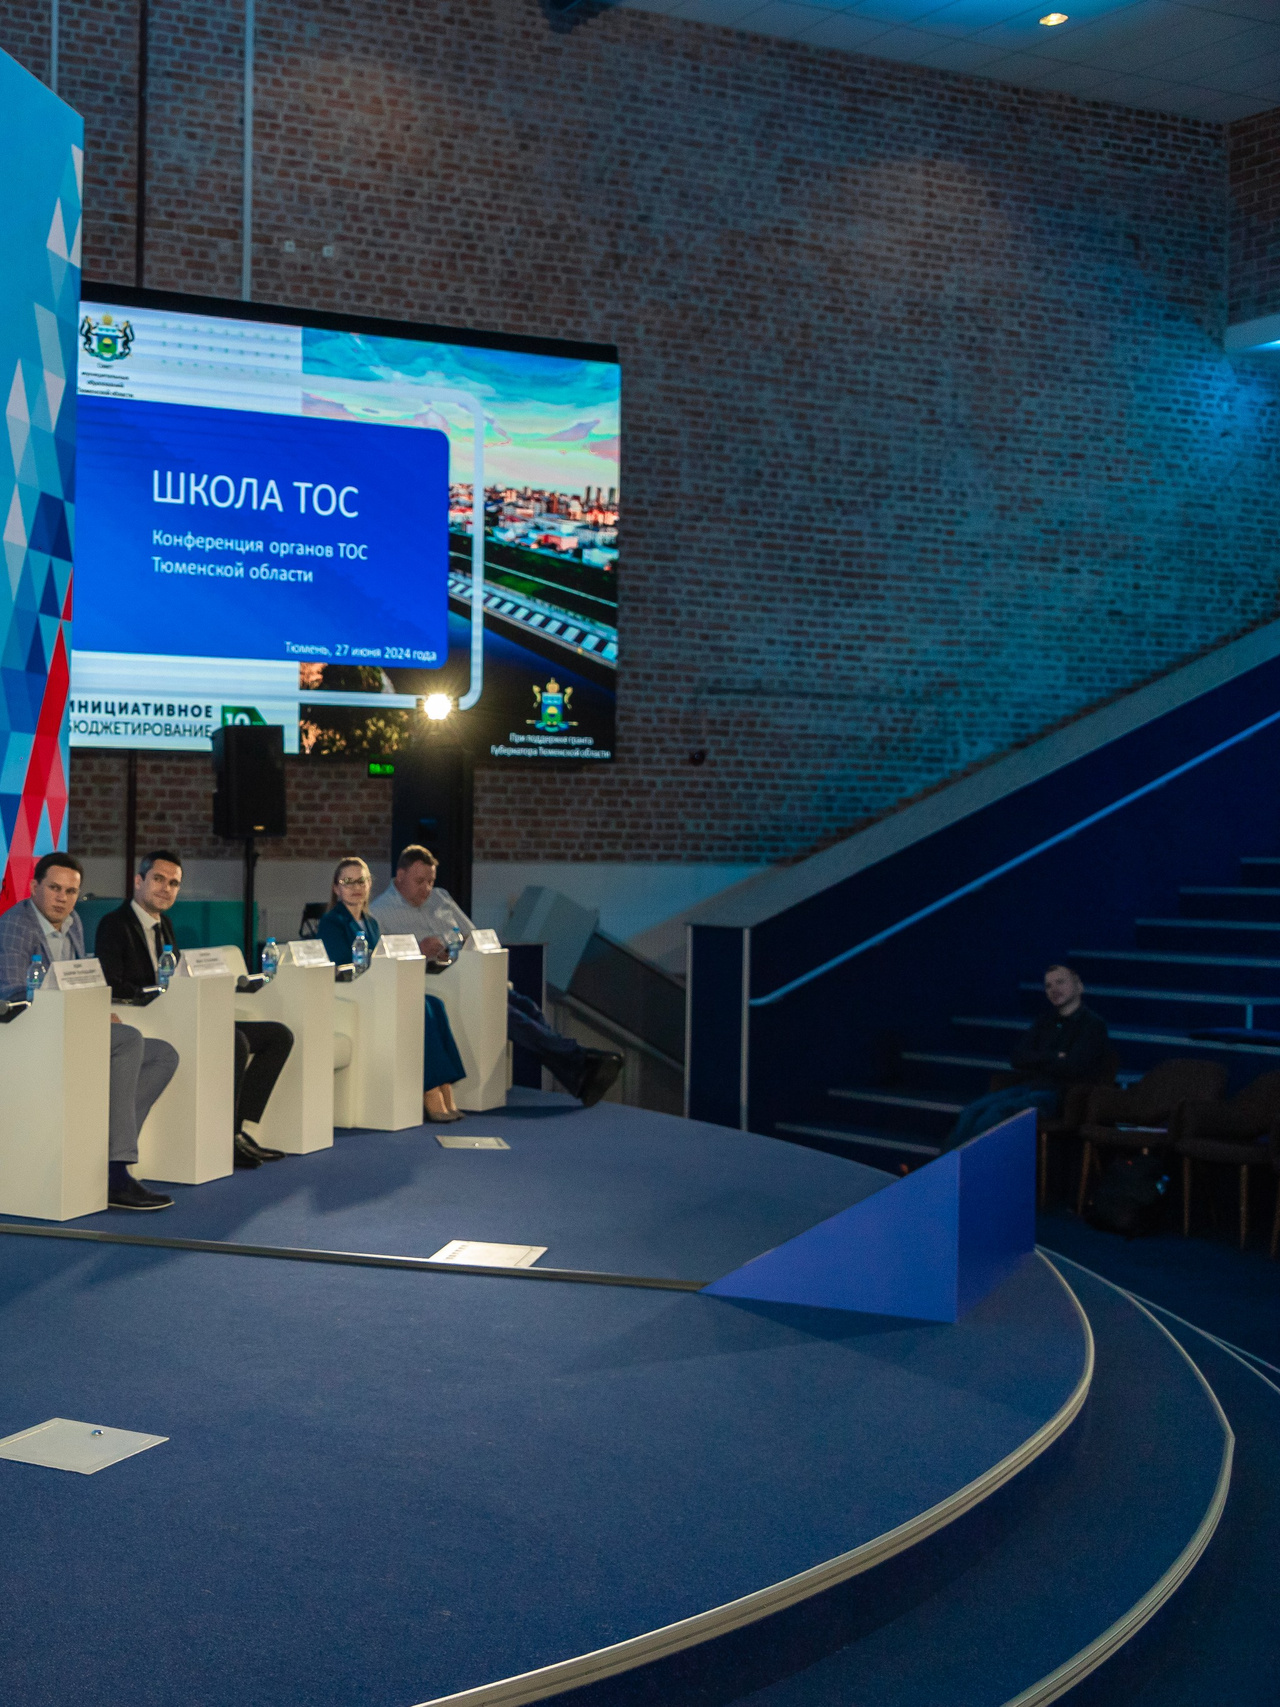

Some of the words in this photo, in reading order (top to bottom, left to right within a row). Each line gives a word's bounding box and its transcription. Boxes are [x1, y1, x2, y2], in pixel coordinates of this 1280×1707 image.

[153, 469, 284, 512] ШКОЛА
[292, 481, 359, 518] ТОС
[152, 529, 264, 554] Конференция
[269, 541, 334, 558] органов
[337, 542, 368, 560] ТОС
[151, 556, 244, 579] Тюменской
[249, 563, 313, 582] области
[284, 641, 332, 657] Тюмень,
[335, 644, 349, 657] 27
[351, 647, 382, 658] июня
[384, 646, 411, 660] 2024
[412, 650, 437, 662] года
[69, 720, 212, 738] ЮДЖЕТИРОВАНИЕ
